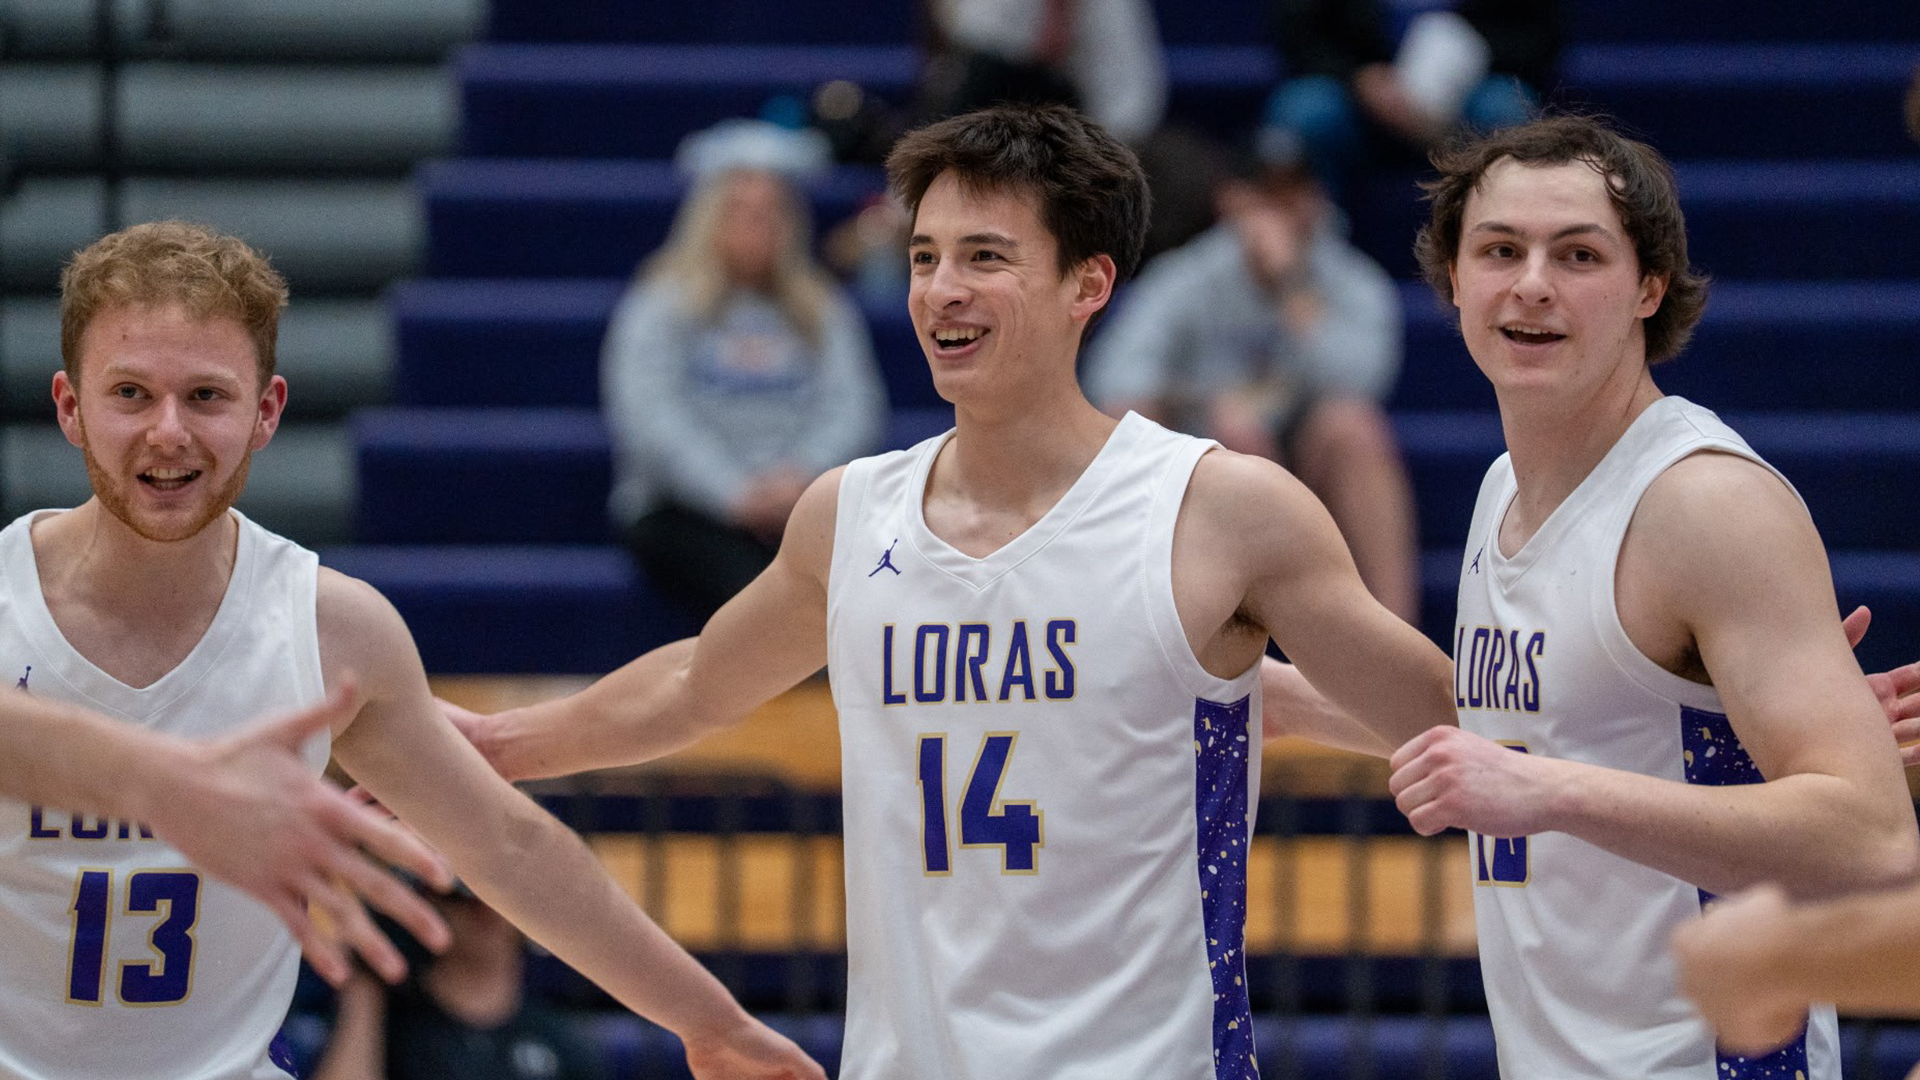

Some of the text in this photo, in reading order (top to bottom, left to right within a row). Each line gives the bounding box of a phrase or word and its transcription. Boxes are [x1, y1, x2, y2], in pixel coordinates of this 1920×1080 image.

[883, 617, 1077, 707] LORAS
[1454, 624, 1546, 713] LORAS
[916, 731, 1045, 877] 14
[65, 867, 203, 1008] 13
